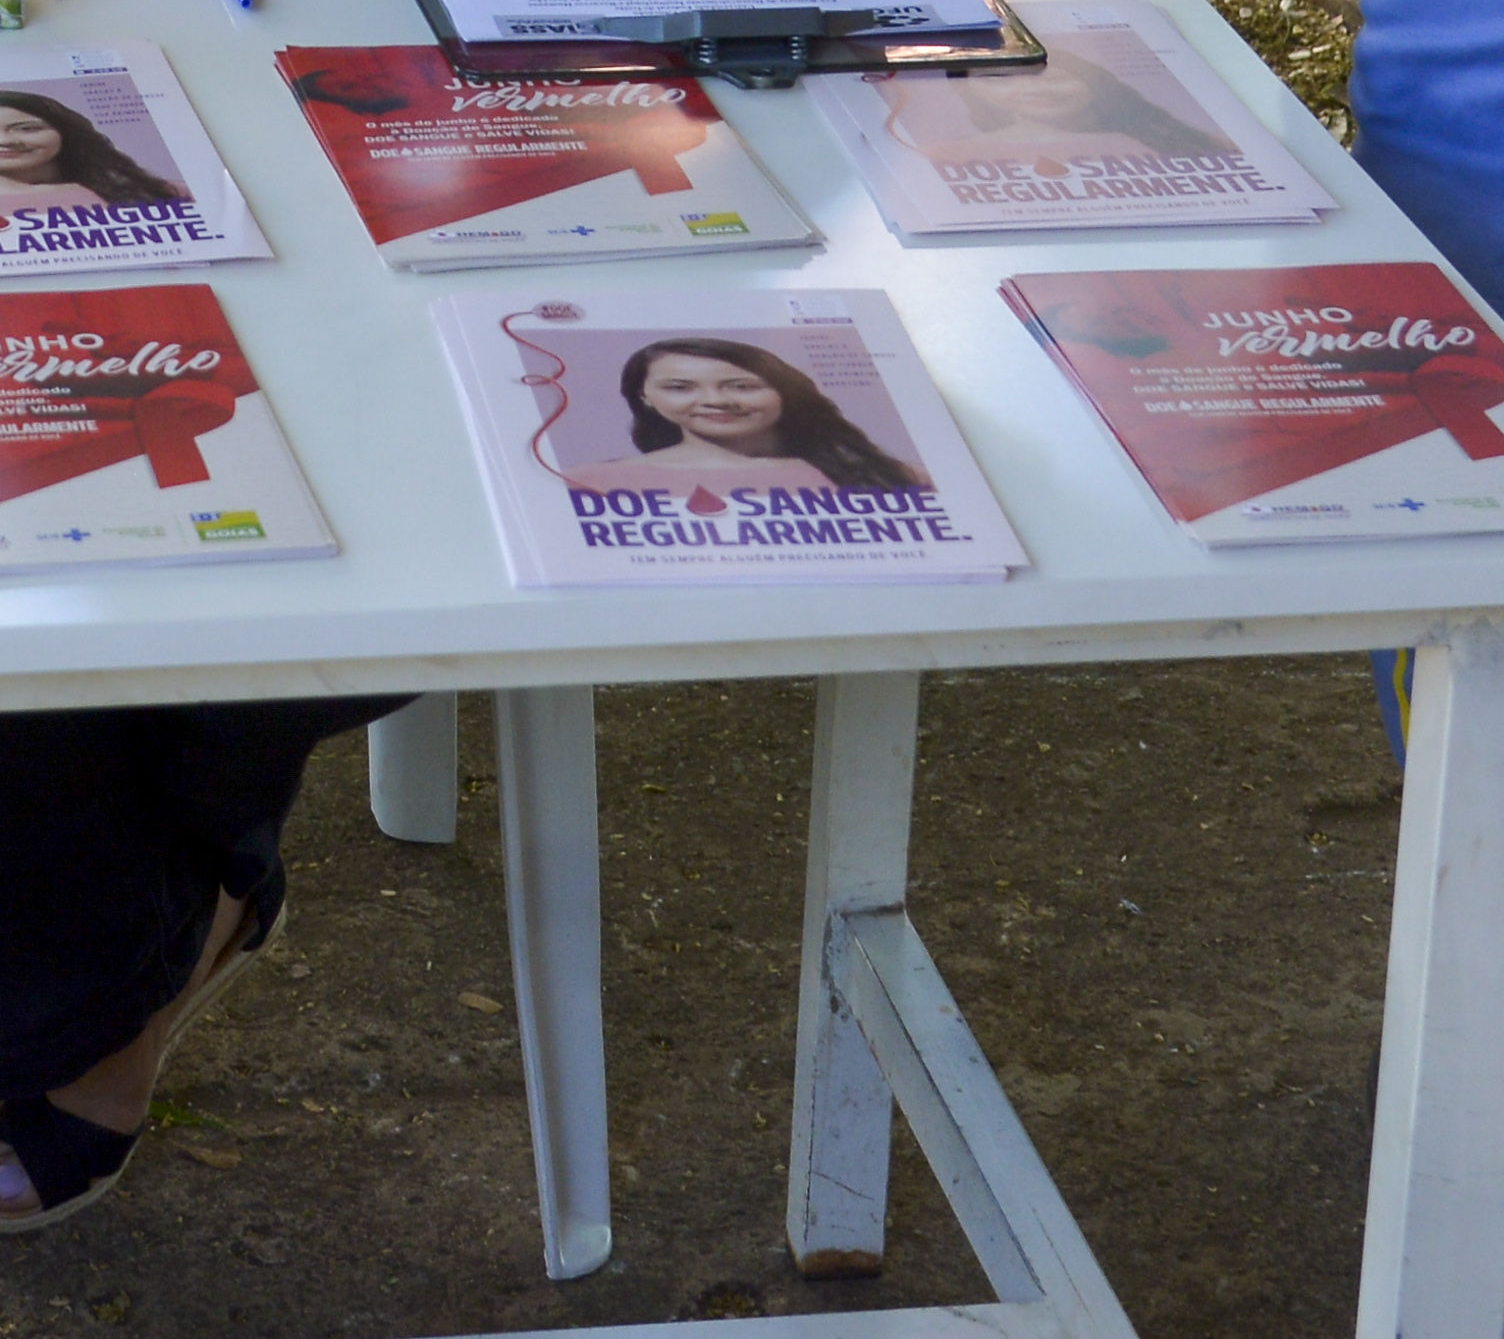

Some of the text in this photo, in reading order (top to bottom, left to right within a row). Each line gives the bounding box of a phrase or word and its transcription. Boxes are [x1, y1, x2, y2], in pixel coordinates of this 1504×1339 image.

[452, 81, 686, 112] vermelho
[370, 140, 587, 159] DOE SANGUE REGULARMENTE
[933, 153, 1256, 182] DOE SANGUE
[949, 172, 1287, 204] REGULARMENTE.
[12, 202, 201, 231] SANGUE
[1202, 306, 1354, 329] JUNHO
[1218, 316, 1476, 358] vermelho
[1144, 394, 1386, 412] DOE SANGUE REGULARMENTE
[567, 485, 946, 517] DOE SANGUE
[578, 515, 974, 547] REGULARMENTE.
